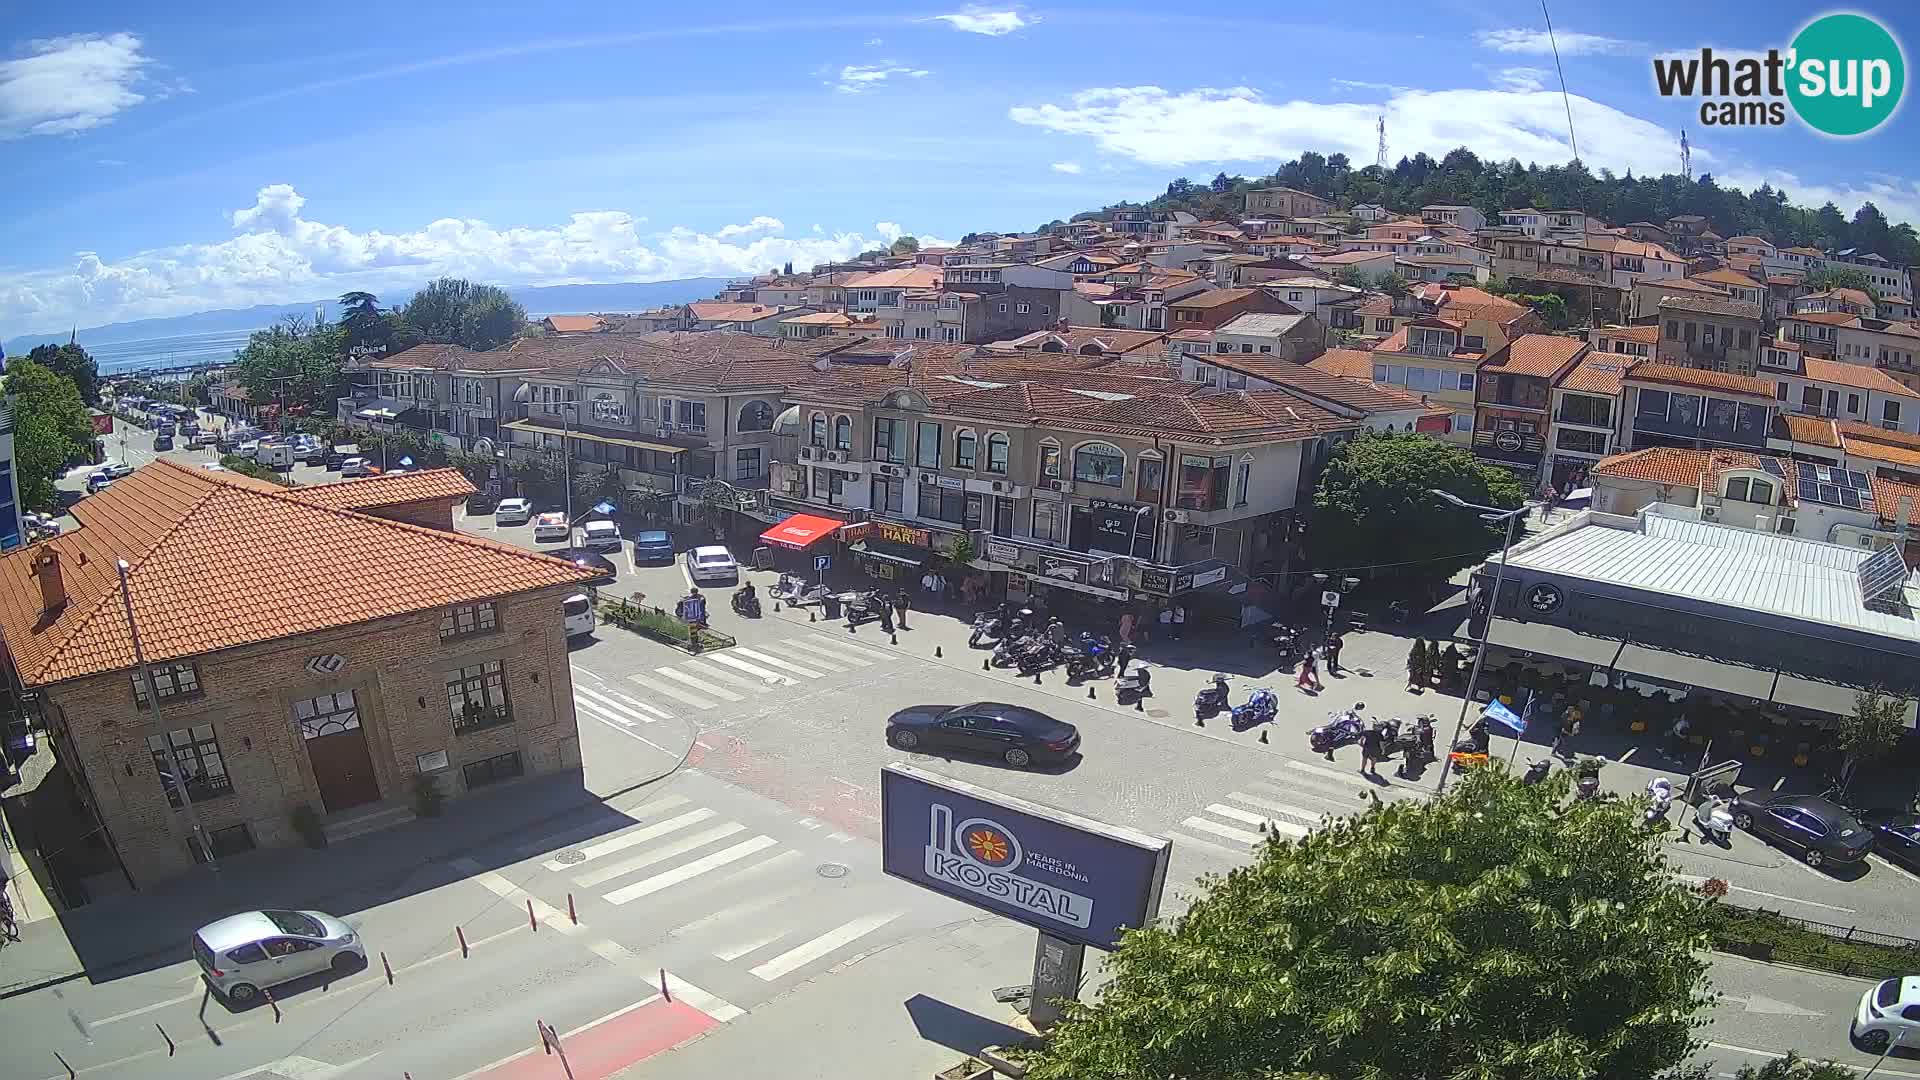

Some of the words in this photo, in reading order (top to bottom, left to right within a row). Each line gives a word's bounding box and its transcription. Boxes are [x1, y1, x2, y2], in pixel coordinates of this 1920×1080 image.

[1026, 857, 1089, 883] MACEDONIA
[1027, 850, 1062, 868] YEARS
[1065, 862, 1076, 872] IN
[934, 852, 1079, 921] KOSTAL
